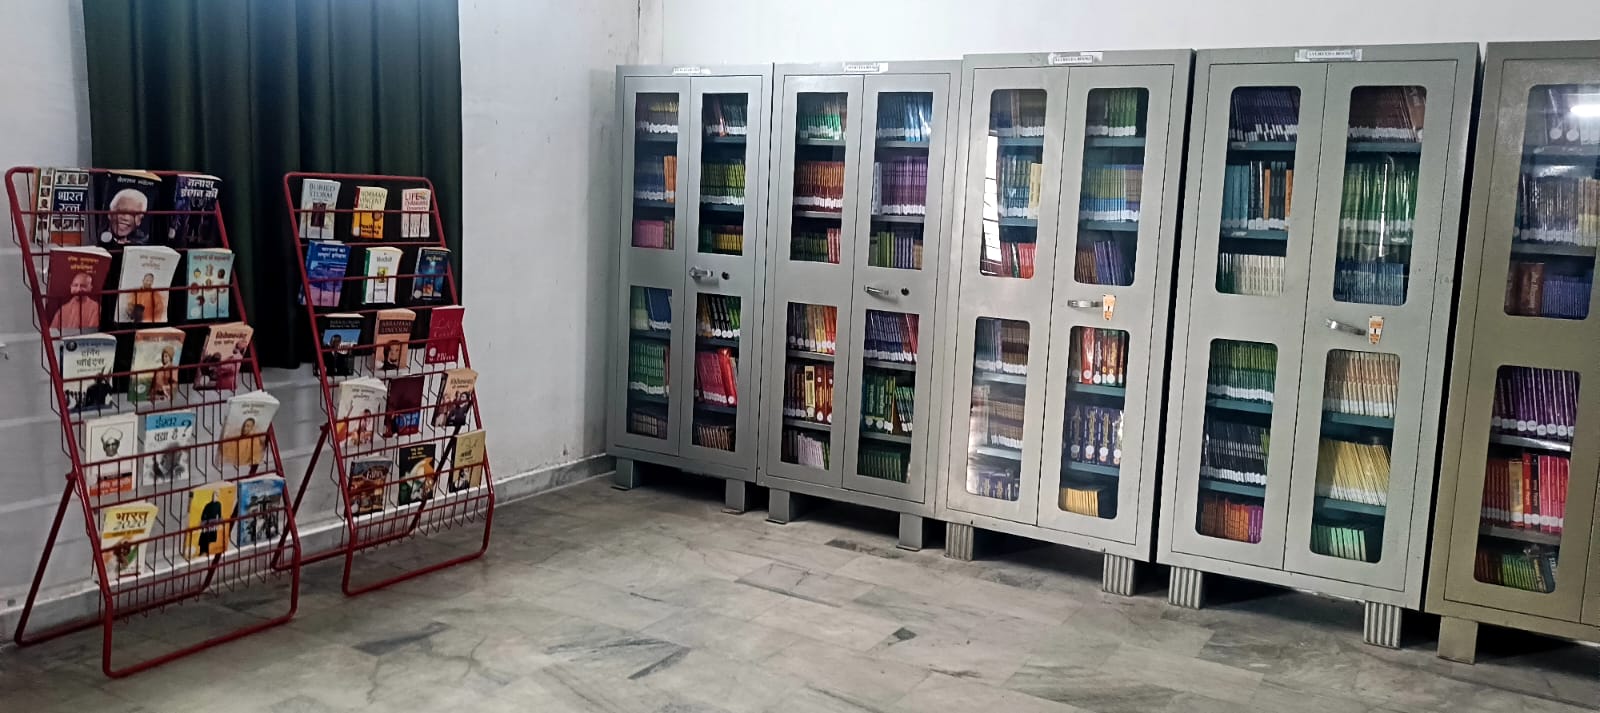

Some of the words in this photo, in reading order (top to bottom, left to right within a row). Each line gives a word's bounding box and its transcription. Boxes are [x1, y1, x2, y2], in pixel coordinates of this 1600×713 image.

[188, 178, 214, 188] तलाश
[58, 191, 84, 201] भारत
[59, 203, 81, 212] रत्न
[154, 431, 168, 441] क्या
[172, 428, 178, 440] है
[181, 419, 192, 437] ?
[116, 511, 149, 523] भारत
[112, 520, 147, 531] 2020
